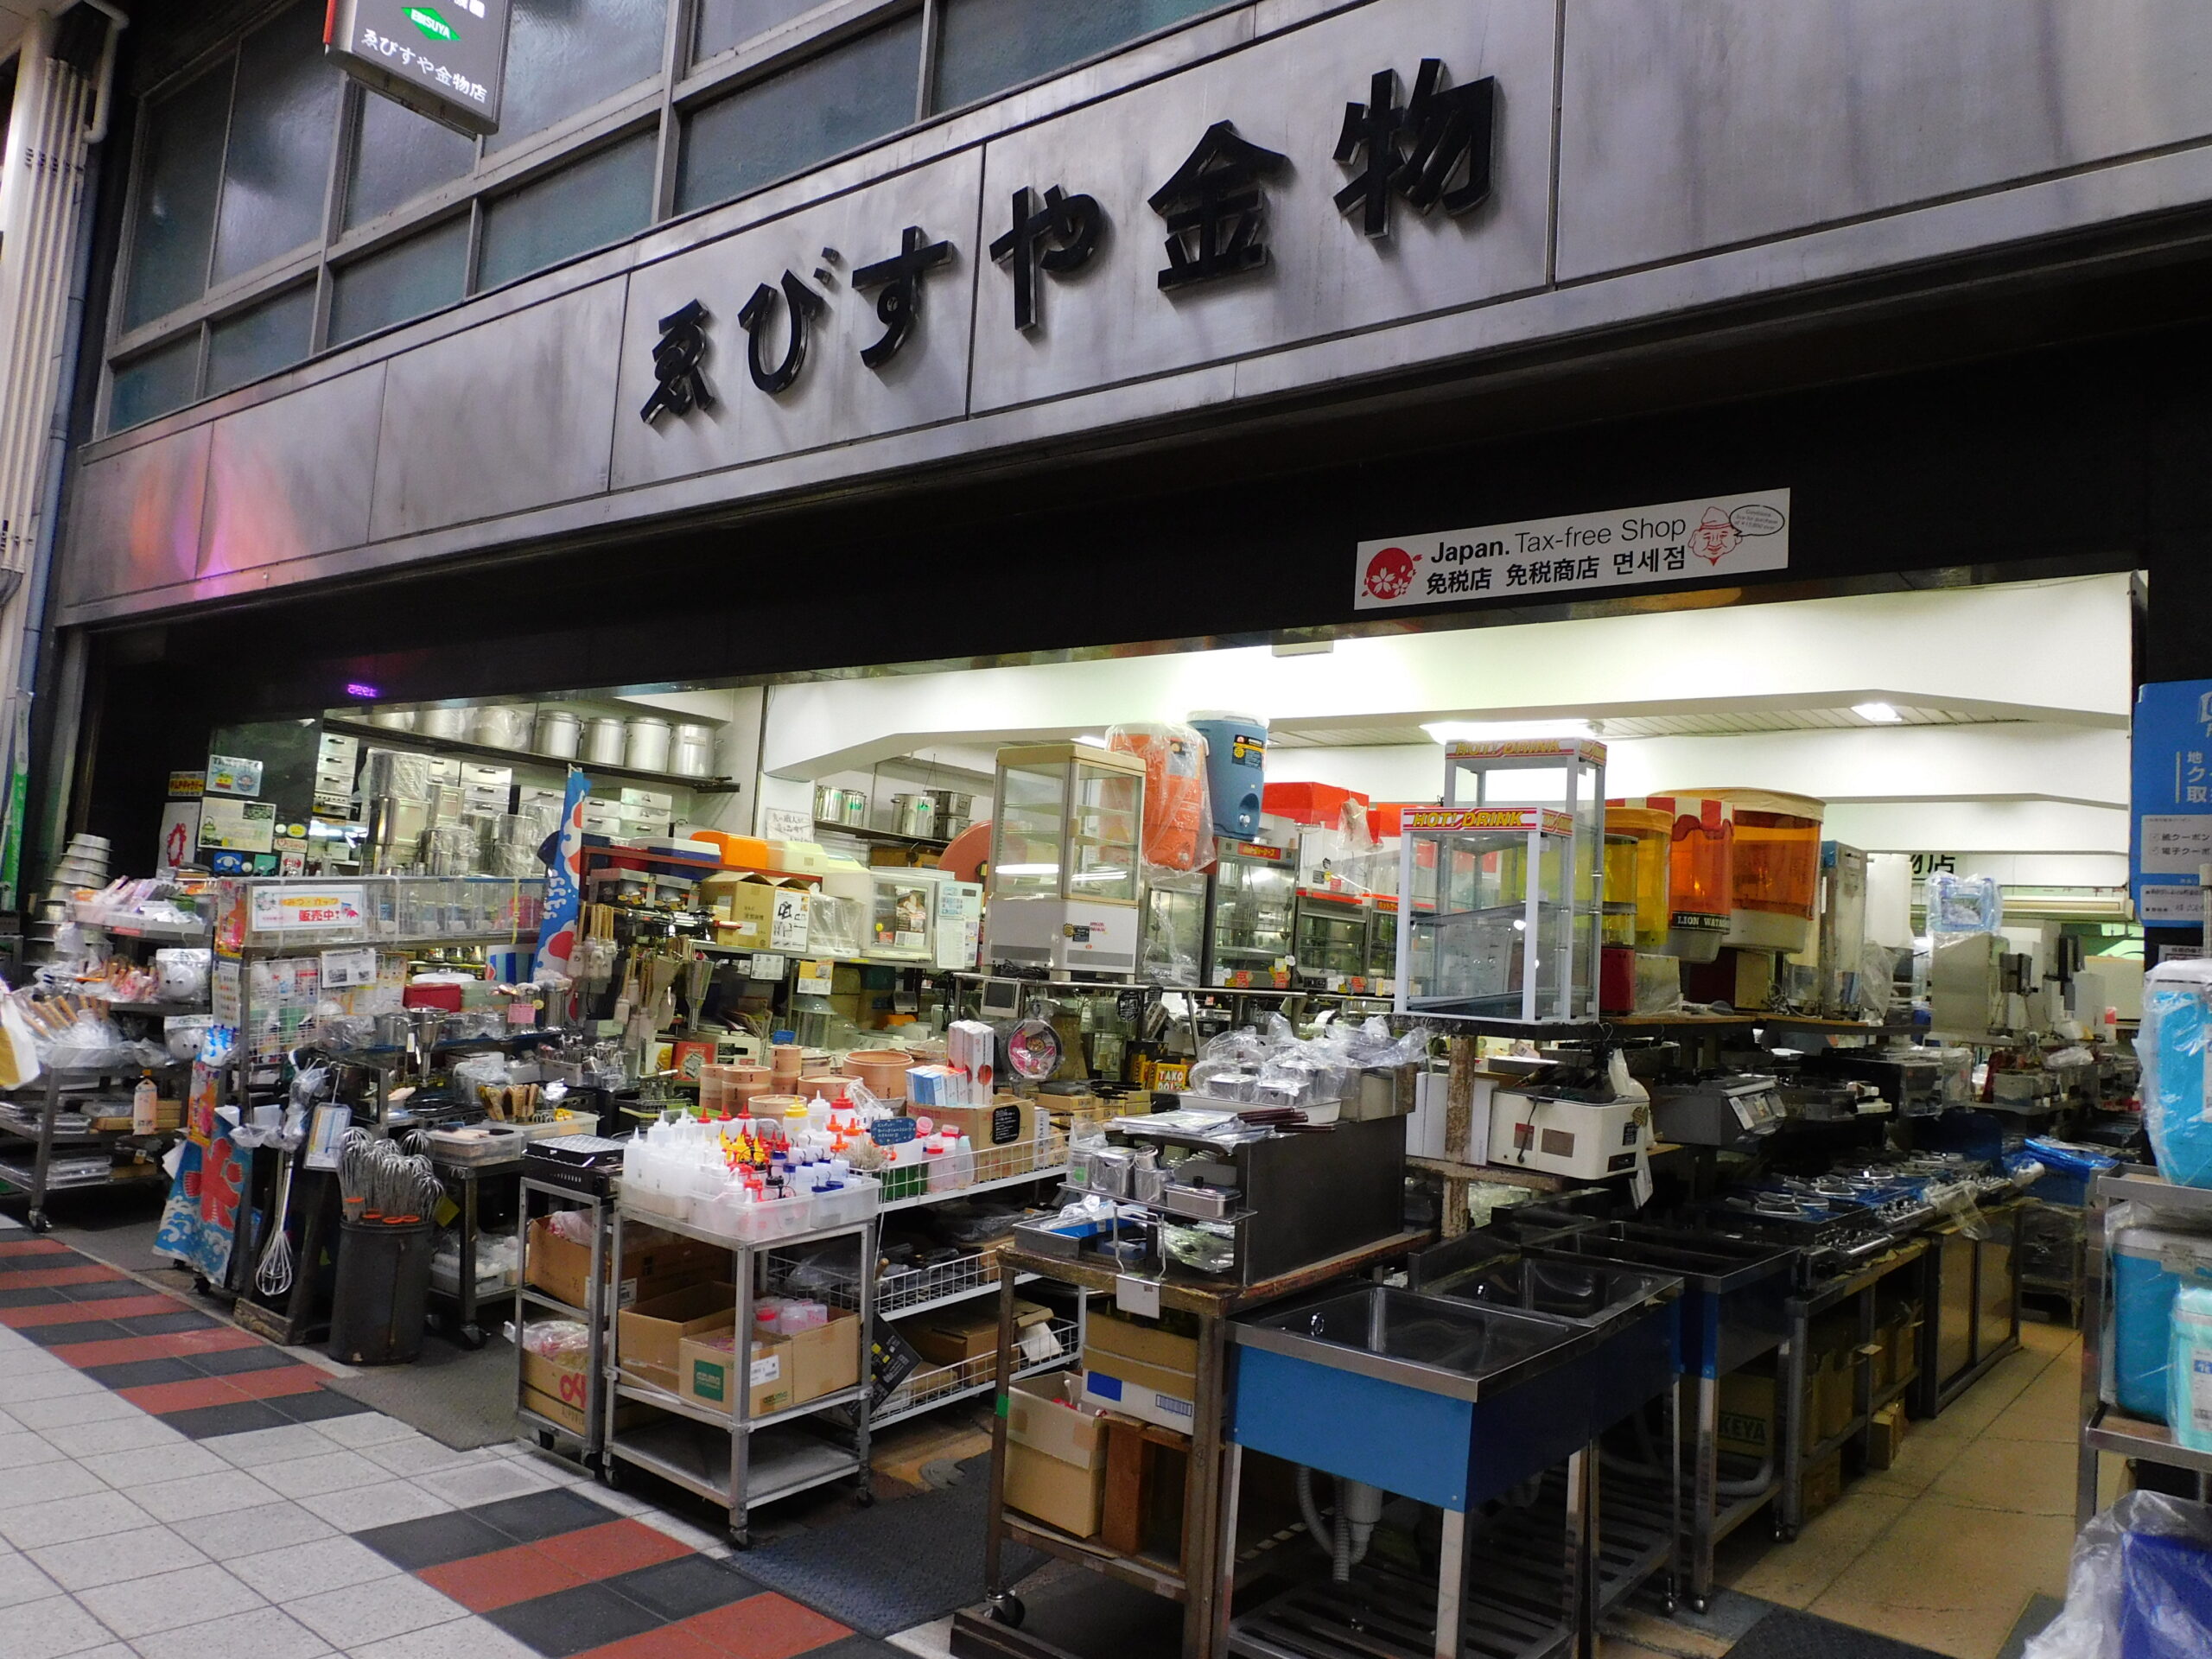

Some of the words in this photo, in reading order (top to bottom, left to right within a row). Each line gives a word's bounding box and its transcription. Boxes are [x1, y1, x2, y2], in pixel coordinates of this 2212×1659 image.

[360, 29, 487, 103] ゑびすや金物店
[640, 57, 1501, 424] ゑびすや金物
[1430, 539, 1510, 566] Japan.
[1515, 525, 1611, 554] Tax-free
[1621, 517, 1686, 543] Shop
[1426, 567, 1492, 596] 免税店
[1505, 557, 1599, 588] 免税商店
[1613, 544, 1686, 575] 면세점
[1502, 740, 1560, 754] DRINK
[2186, 785, 2212, 803] 取
[1413, 811, 1457, 827] HOT!
[1461, 810, 1523, 827] DRINK
[1677, 915, 1700, 925] LION
